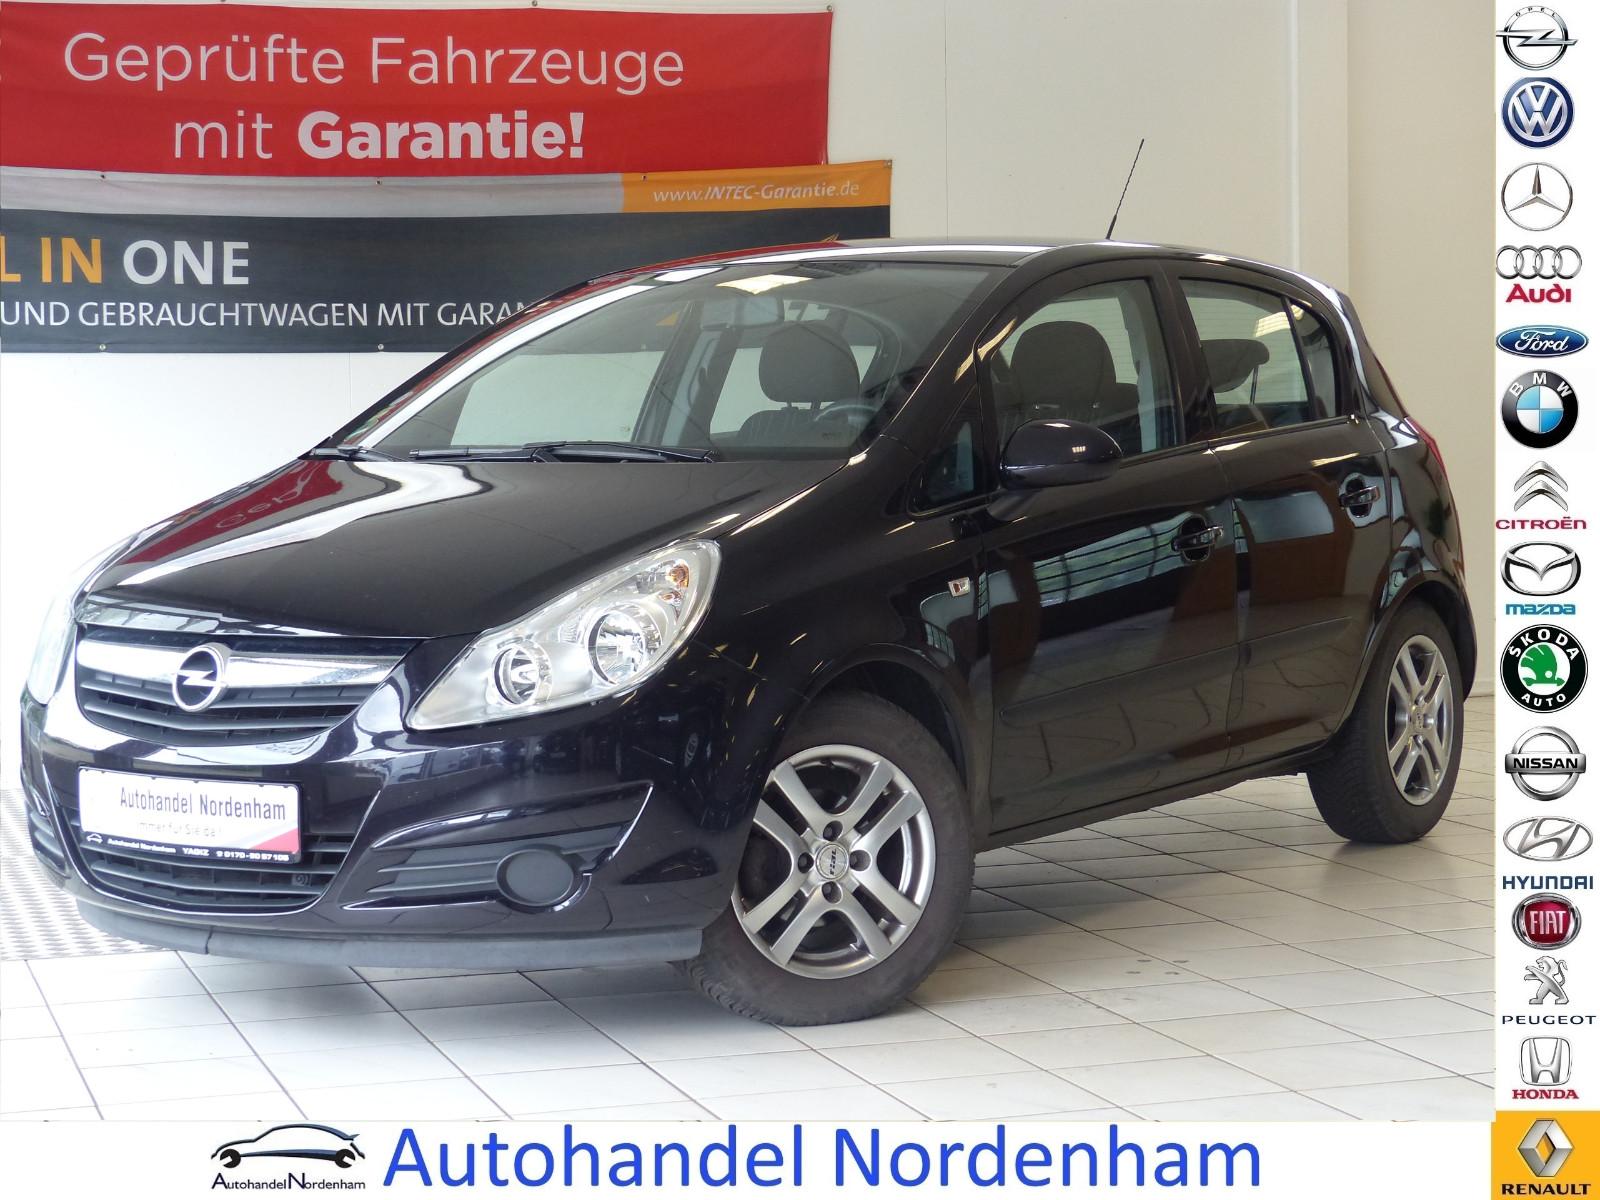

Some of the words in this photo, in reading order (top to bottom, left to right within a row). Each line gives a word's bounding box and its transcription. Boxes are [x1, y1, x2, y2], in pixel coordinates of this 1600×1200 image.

[64, 31, 345, 91] Geprüfte
[372, 36, 684, 96] Fahrzeuge
[174, 110, 273, 159] mit
[298, 110, 584, 160] Garantie!
[653, 181, 860, 202] www.INTEC-Garantie.de
[41, 237, 103, 284] IN
[123, 240, 249, 285] ONE
[0, 301, 70, 326] UND
[78, 302, 368, 327] GEBRAUCHTWAGEN
[377, 303, 430, 326] MIT
[120, 787, 193, 813] Autohandel
[199, 794, 287, 821] Nordenham
